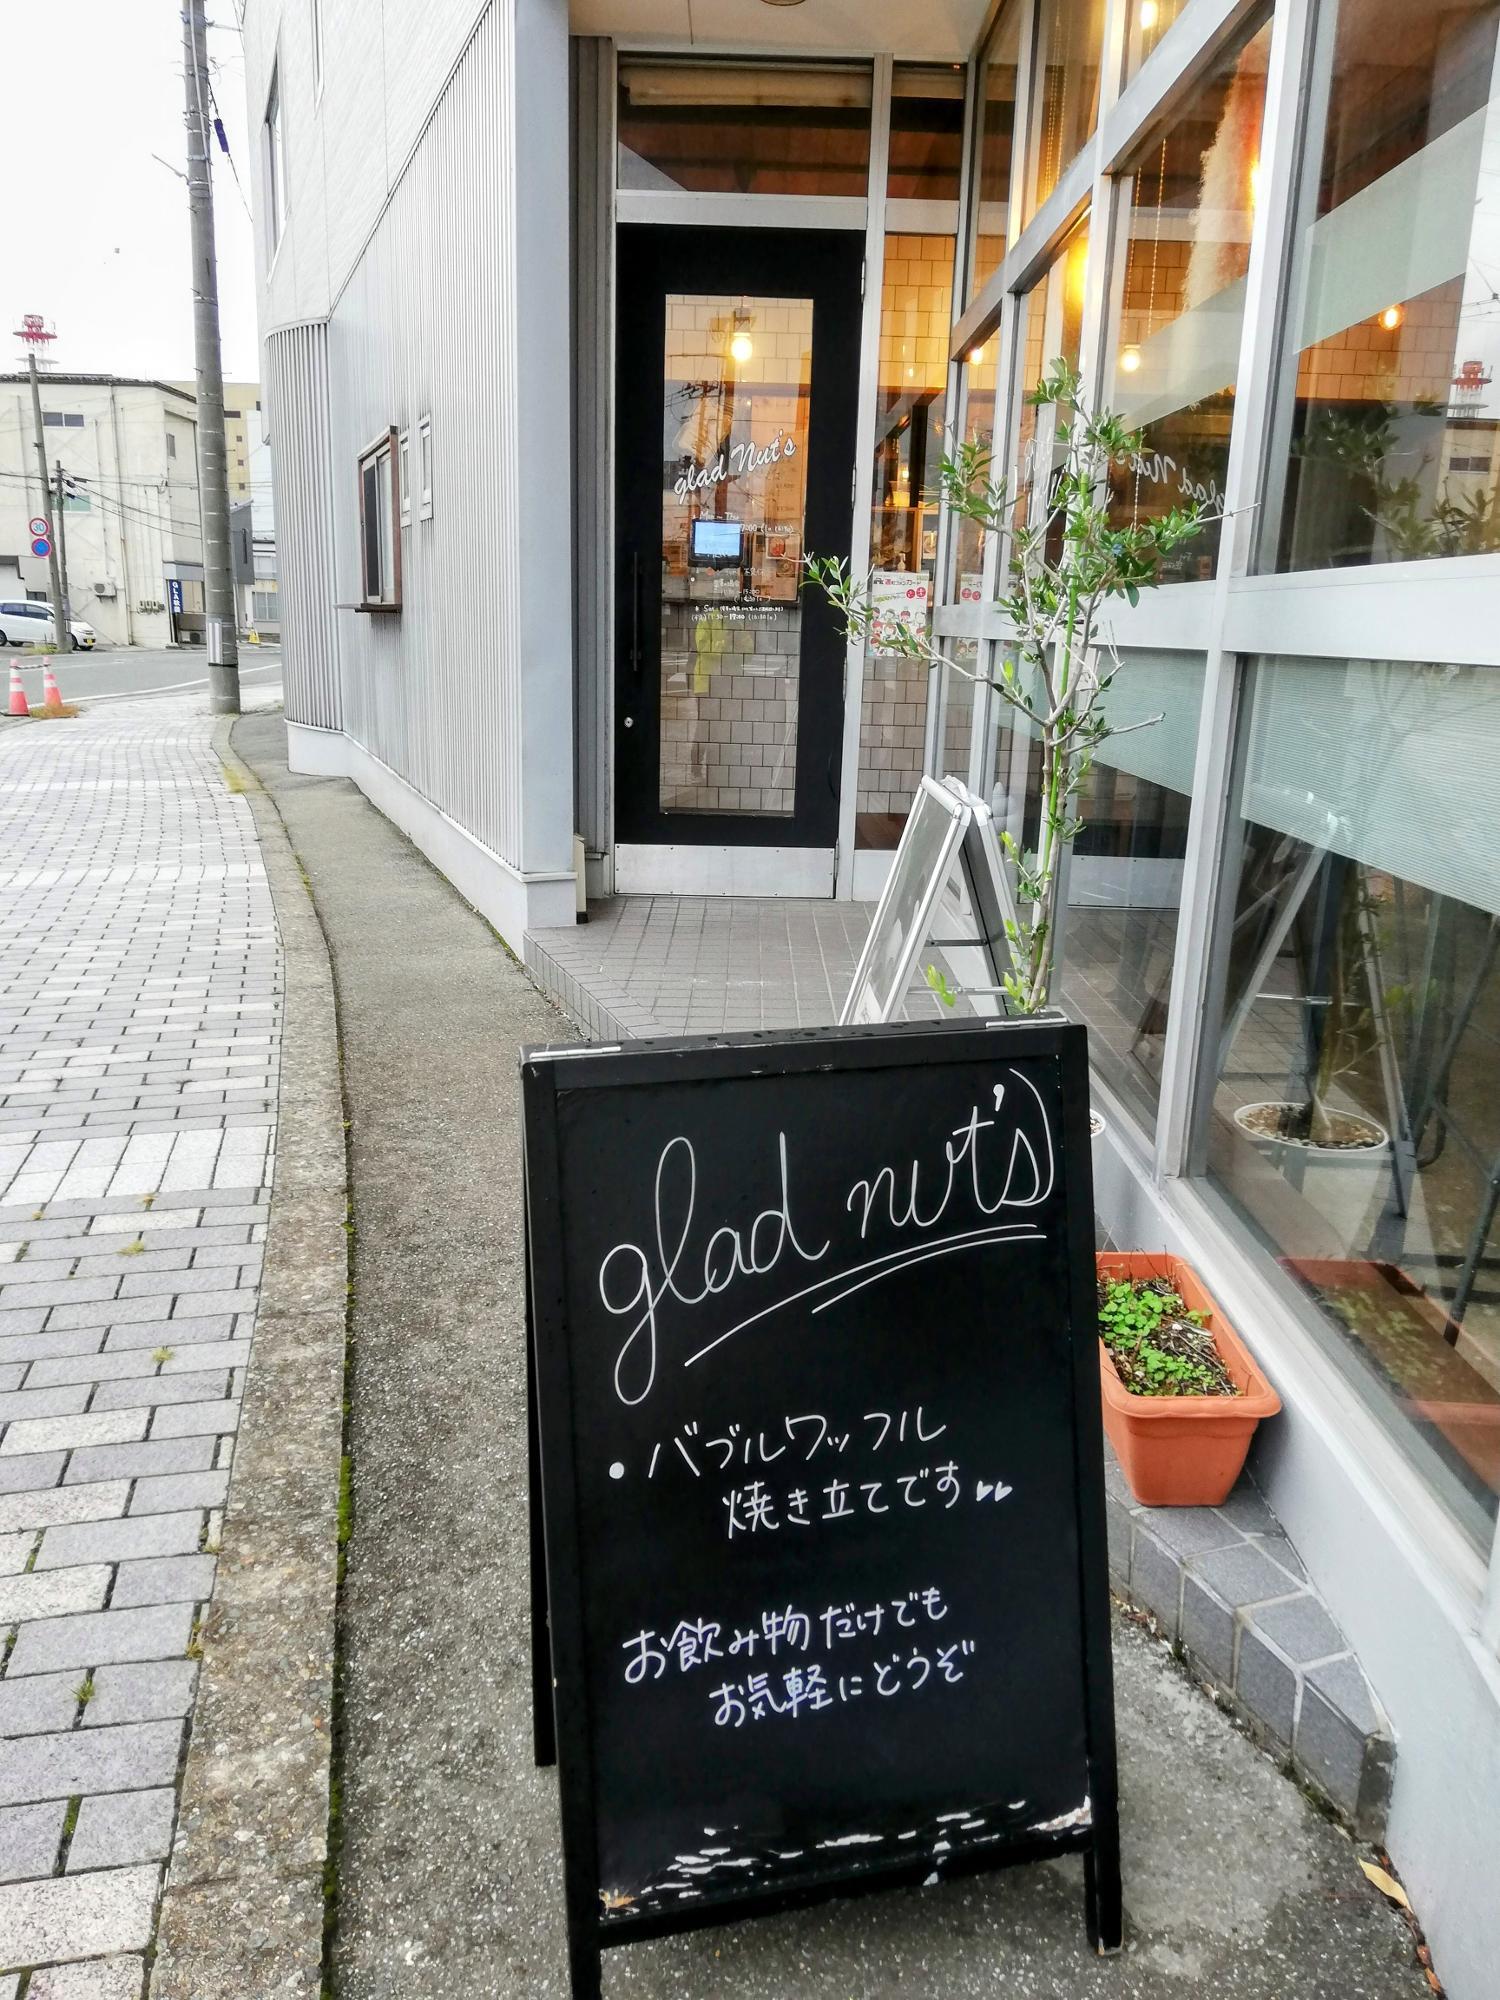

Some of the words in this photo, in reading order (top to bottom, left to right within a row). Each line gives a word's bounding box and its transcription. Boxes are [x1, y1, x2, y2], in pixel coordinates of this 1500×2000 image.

[674, 454, 727, 505] glad
[730, 429, 797, 472] Nut's
[599, 1132, 830, 1405] glad
[846, 1067, 1055, 1239] nut's
[621, 1586, 948, 1684] お飲み物だけでも
[709, 1640, 975, 1728] お気軽にどうぞ
